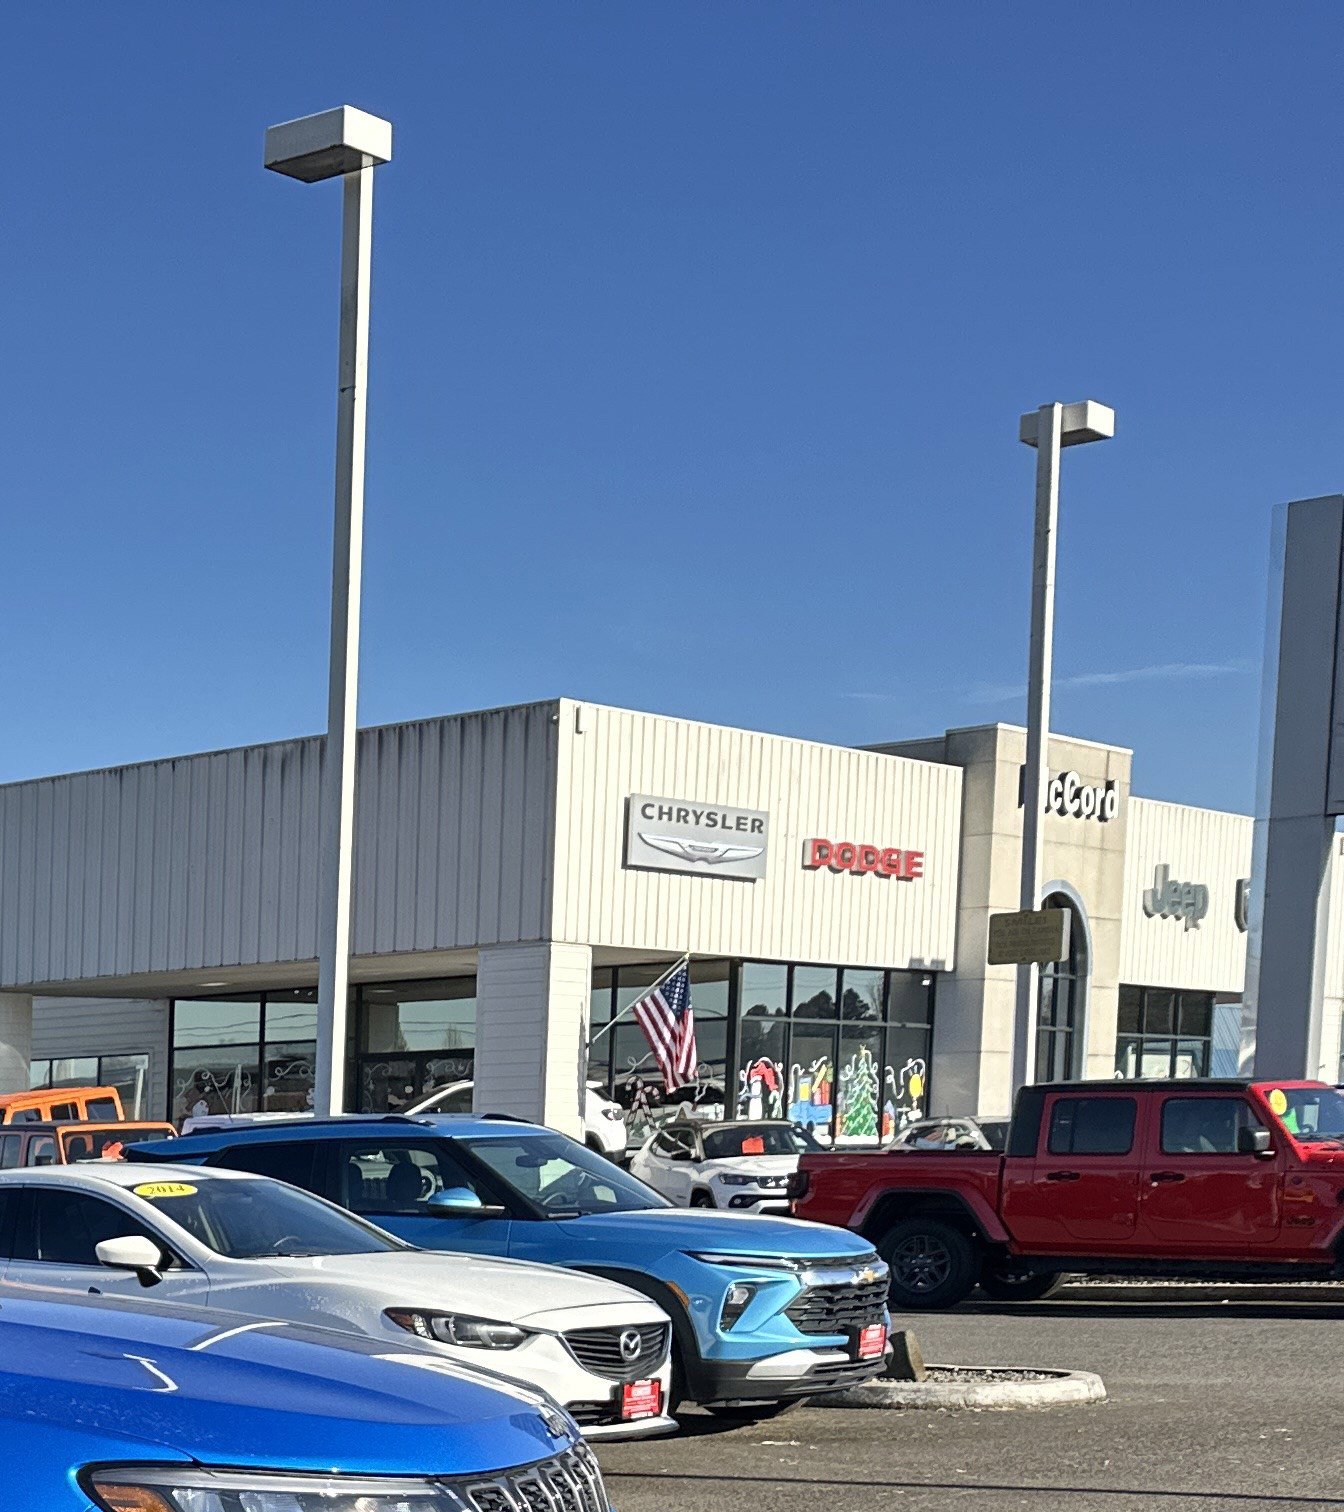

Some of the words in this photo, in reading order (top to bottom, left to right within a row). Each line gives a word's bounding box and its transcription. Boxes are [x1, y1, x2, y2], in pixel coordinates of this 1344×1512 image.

[1020, 765, 1119, 822] cCord
[640, 802, 764, 834] CHRYSLER
[808, 838, 924, 878] DODGE
[1143, 863, 1209, 931] Jeep
[146, 1184, 186, 1195] 2014
